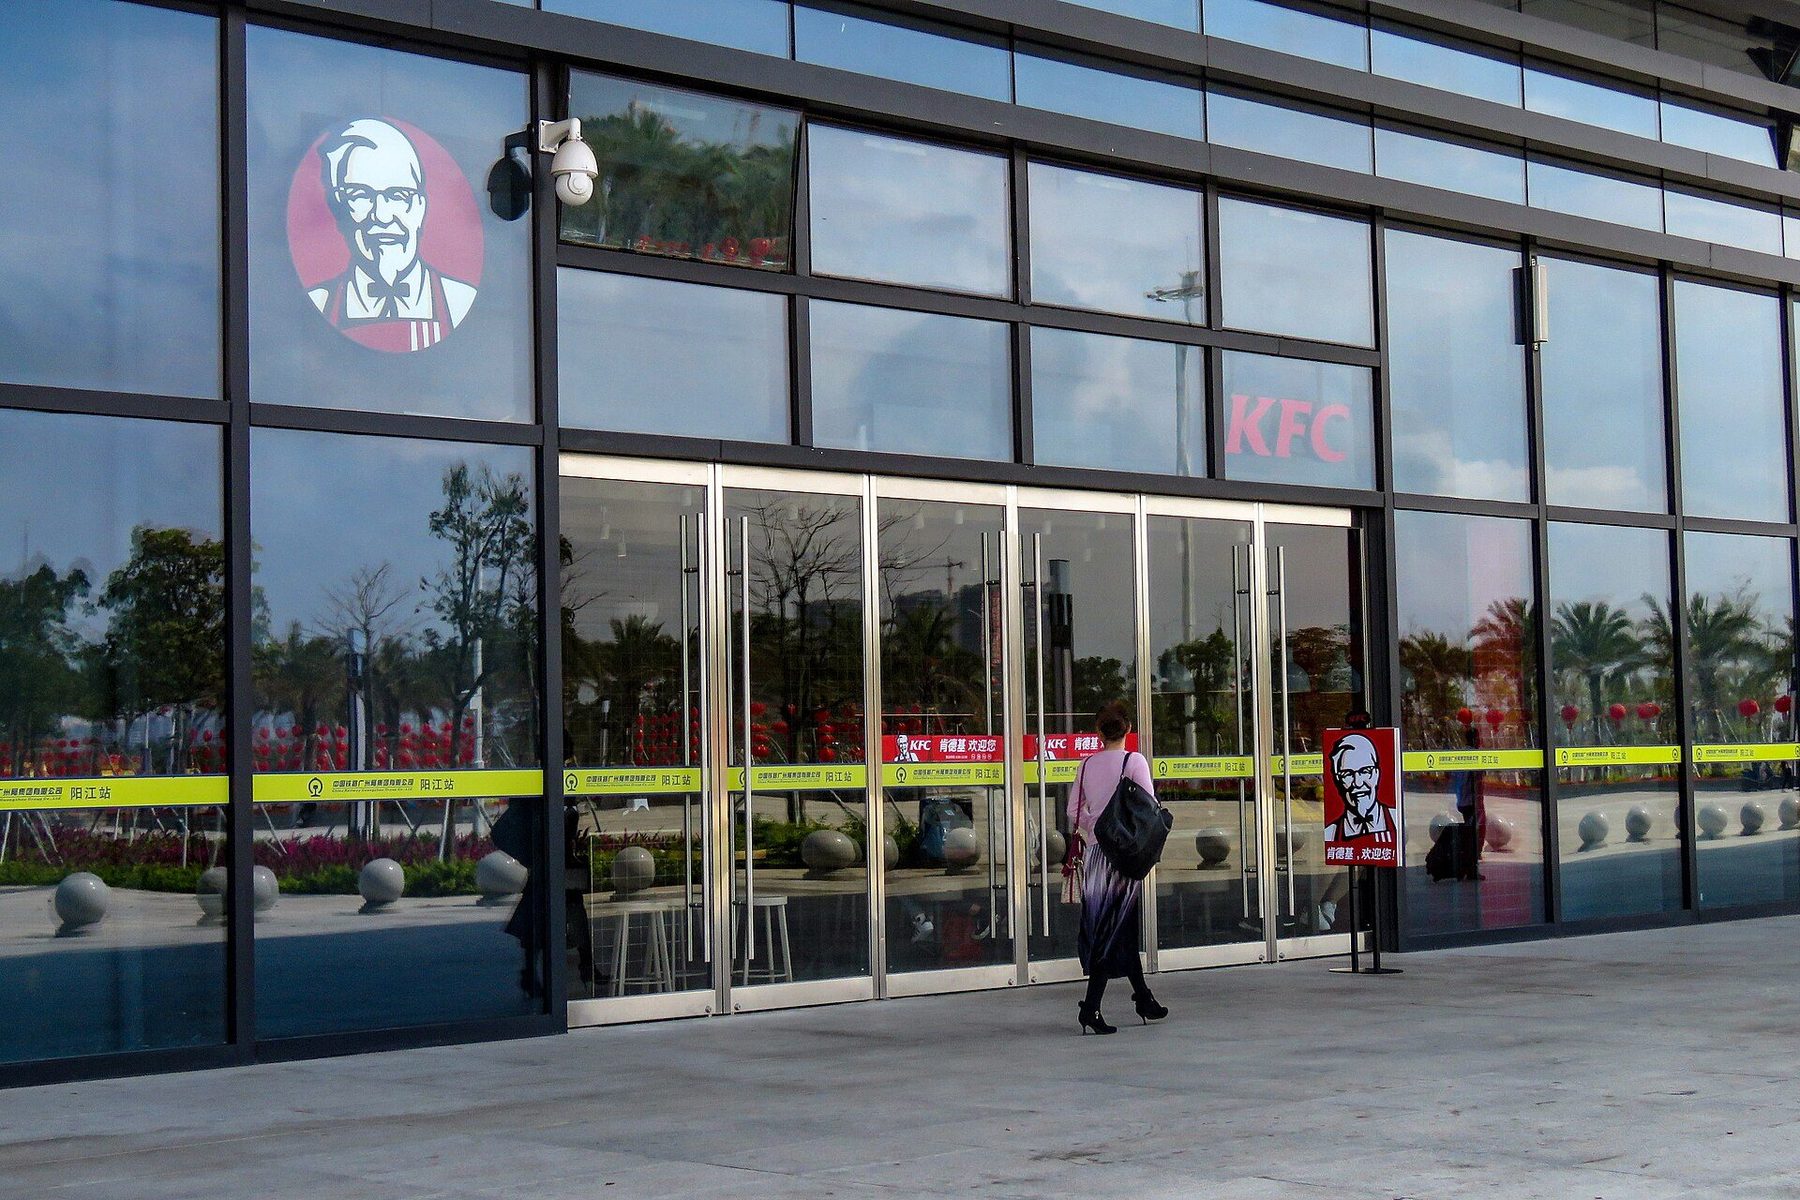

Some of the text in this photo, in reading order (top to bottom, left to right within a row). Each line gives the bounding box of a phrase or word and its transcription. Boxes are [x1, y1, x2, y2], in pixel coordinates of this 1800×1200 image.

[1225, 395, 1350, 462] KFC
[909, 740, 931, 751] KFC
[940, 738, 996, 752] 肯德基 欢迎您
[1047, 738, 1067, 749] KFC
[1074, 736, 1099, 750] 肯德基
[825, 771, 852, 782] 阳江站
[975, 768, 1000, 779] 阳江站
[420, 778, 454, 790] 阳江站
[661, 774, 691, 786] 阳江站
[70, 786, 111, 800] 阳江站
